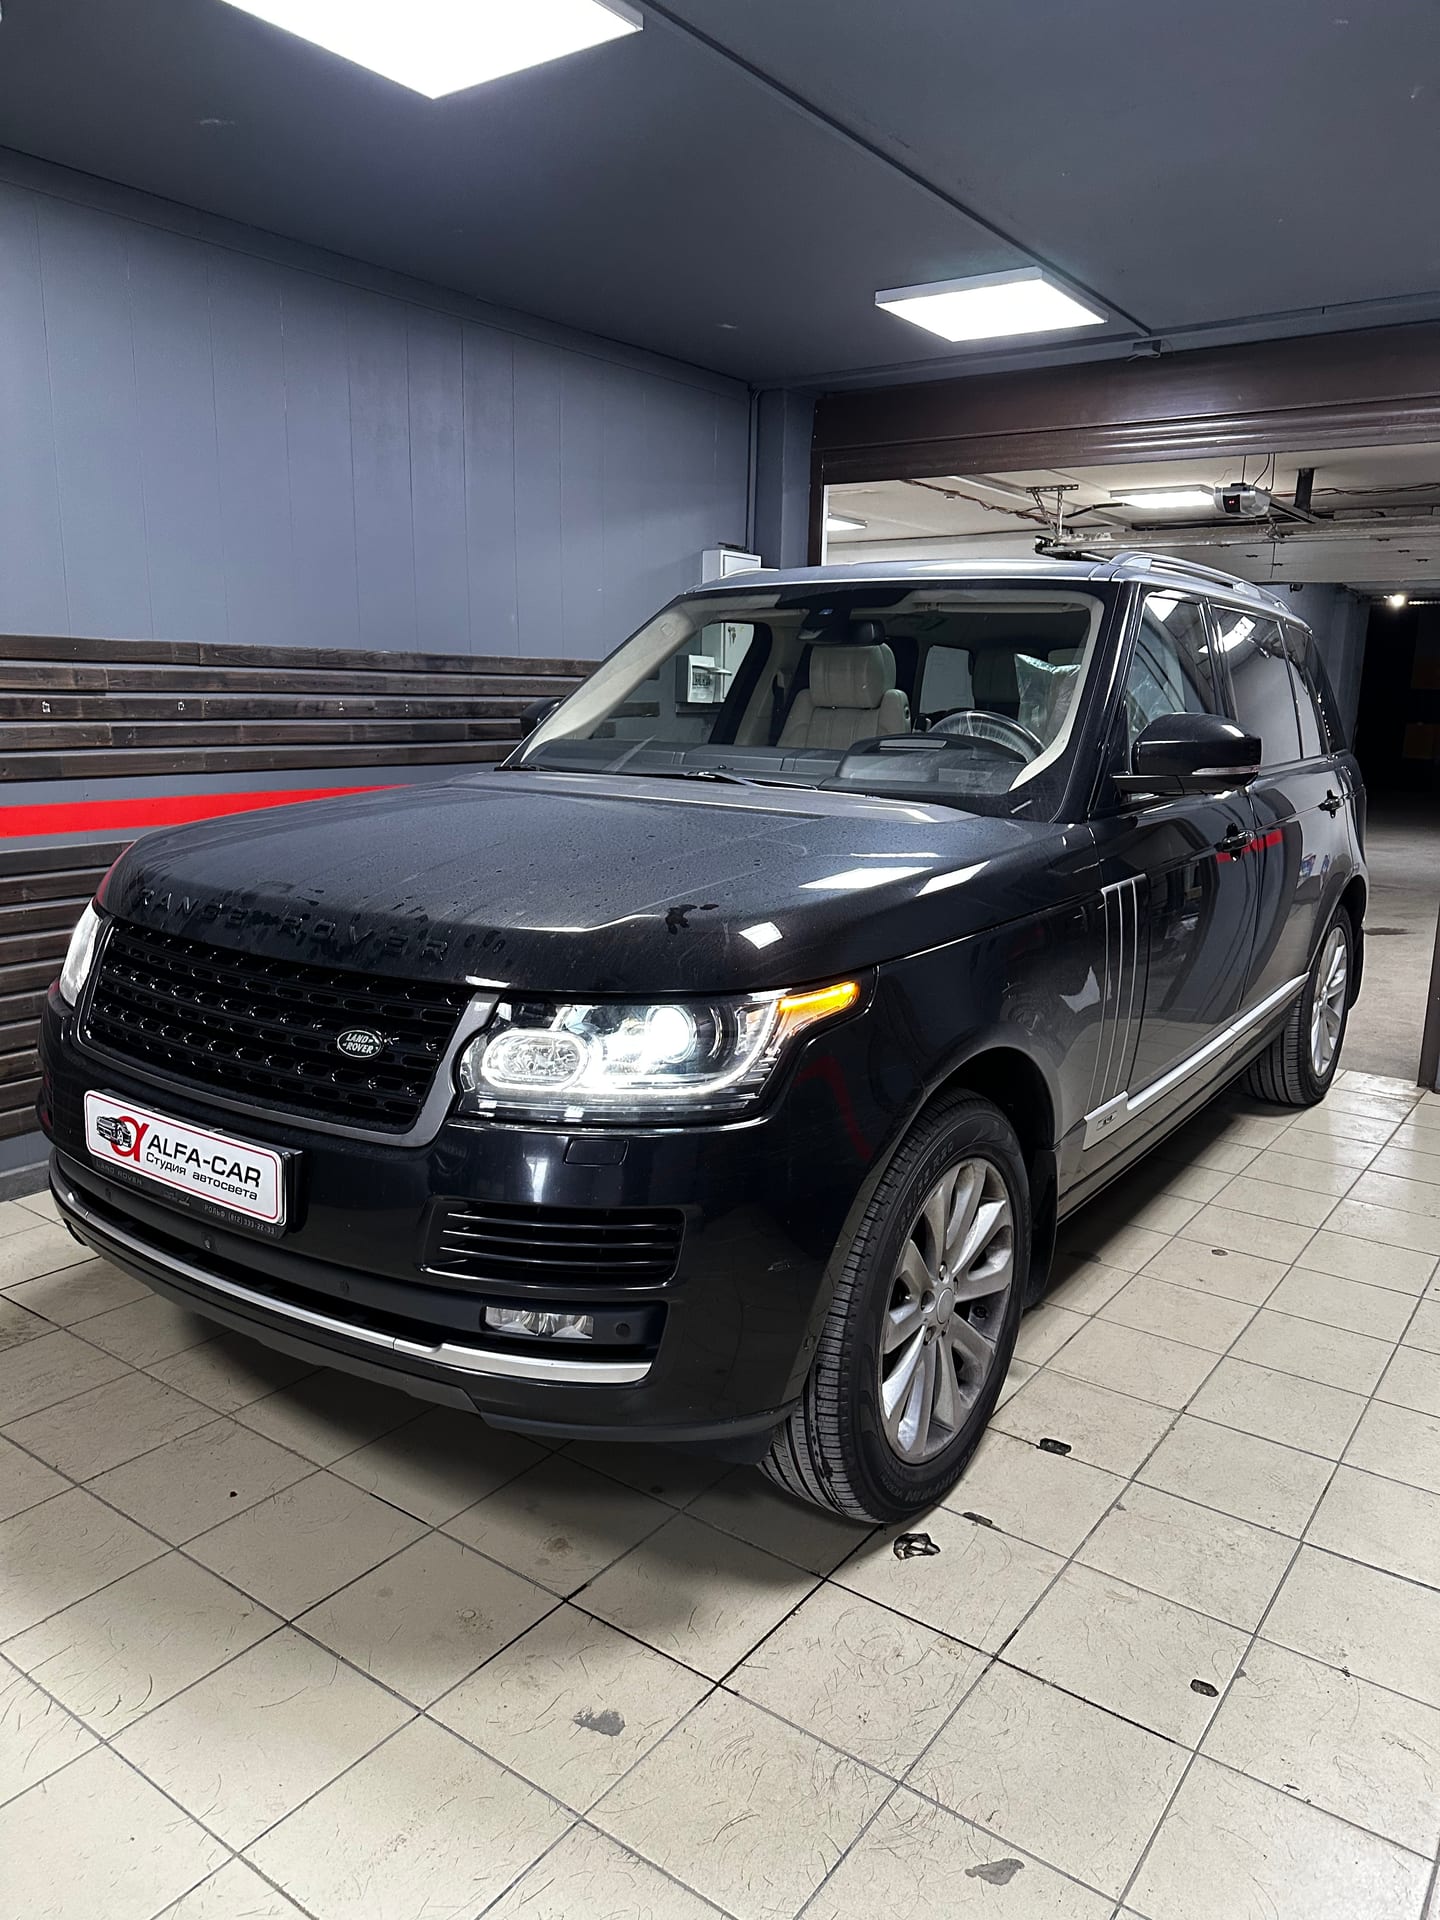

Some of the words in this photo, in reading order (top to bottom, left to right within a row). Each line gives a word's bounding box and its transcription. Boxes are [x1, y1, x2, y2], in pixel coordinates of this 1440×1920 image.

[138, 888, 249, 926] RANGE
[278, 908, 449, 961] ROVER
[345, 1033, 369, 1044] LAND
[345, 1042, 374, 1054] ROVER
[146, 1152, 187, 1176] Студия
[192, 1172, 258, 1201] автосвета
[147, 1134, 261, 1188] ALFA-CAR
